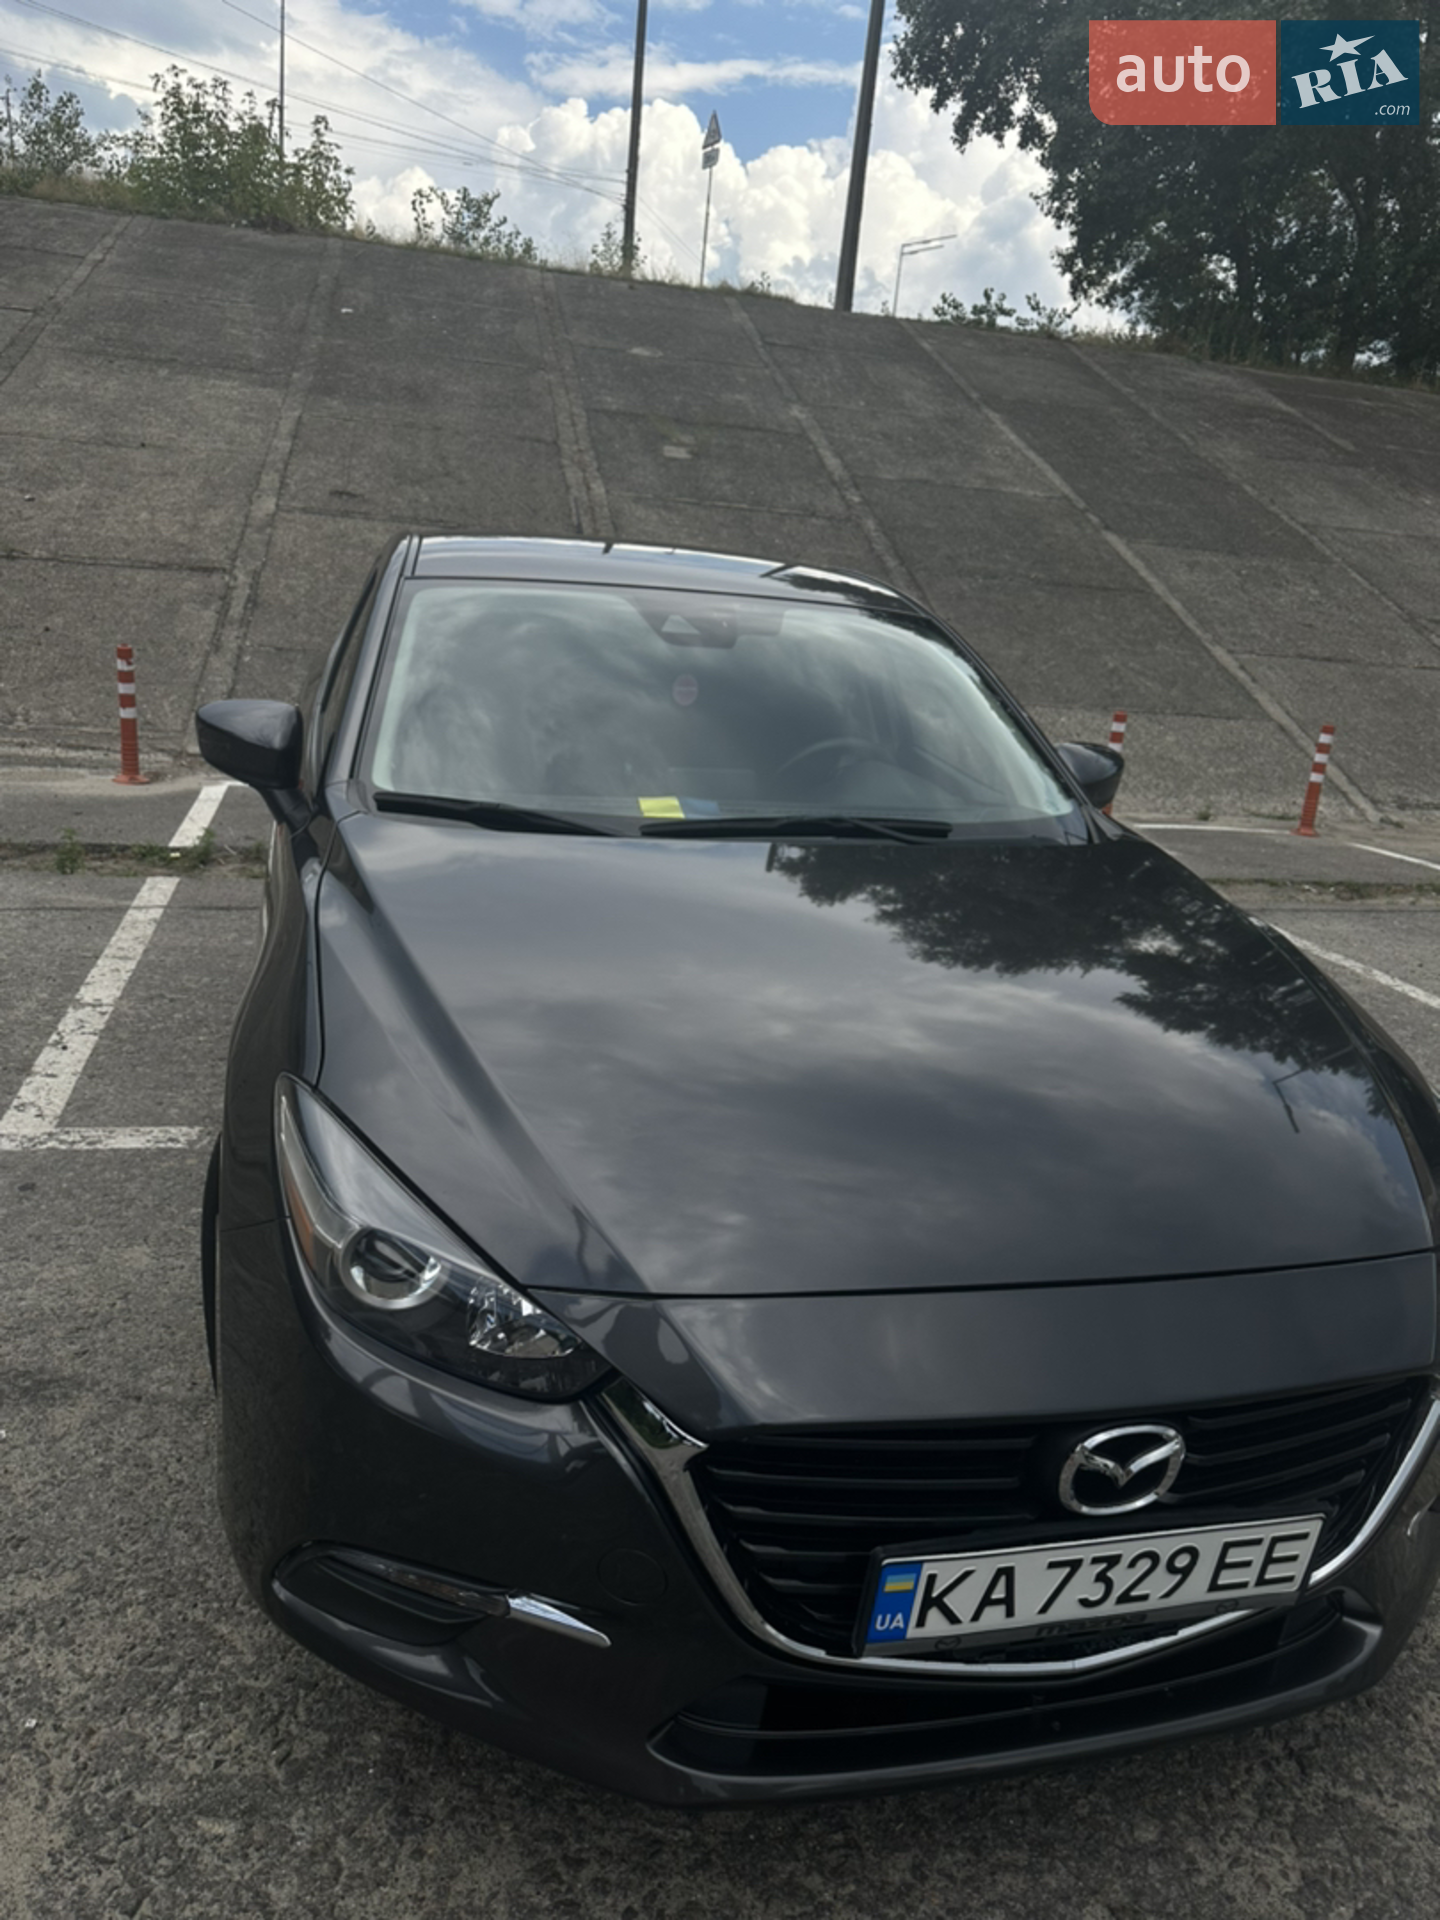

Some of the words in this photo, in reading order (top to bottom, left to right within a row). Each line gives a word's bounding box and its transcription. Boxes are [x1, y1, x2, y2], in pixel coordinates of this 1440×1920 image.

[914, 1567, 1017, 1629] KA
[1036, 1545, 1201, 1615] 7329
[1206, 1531, 1311, 1593] EE
[875, 1612, 905, 1631] UA
